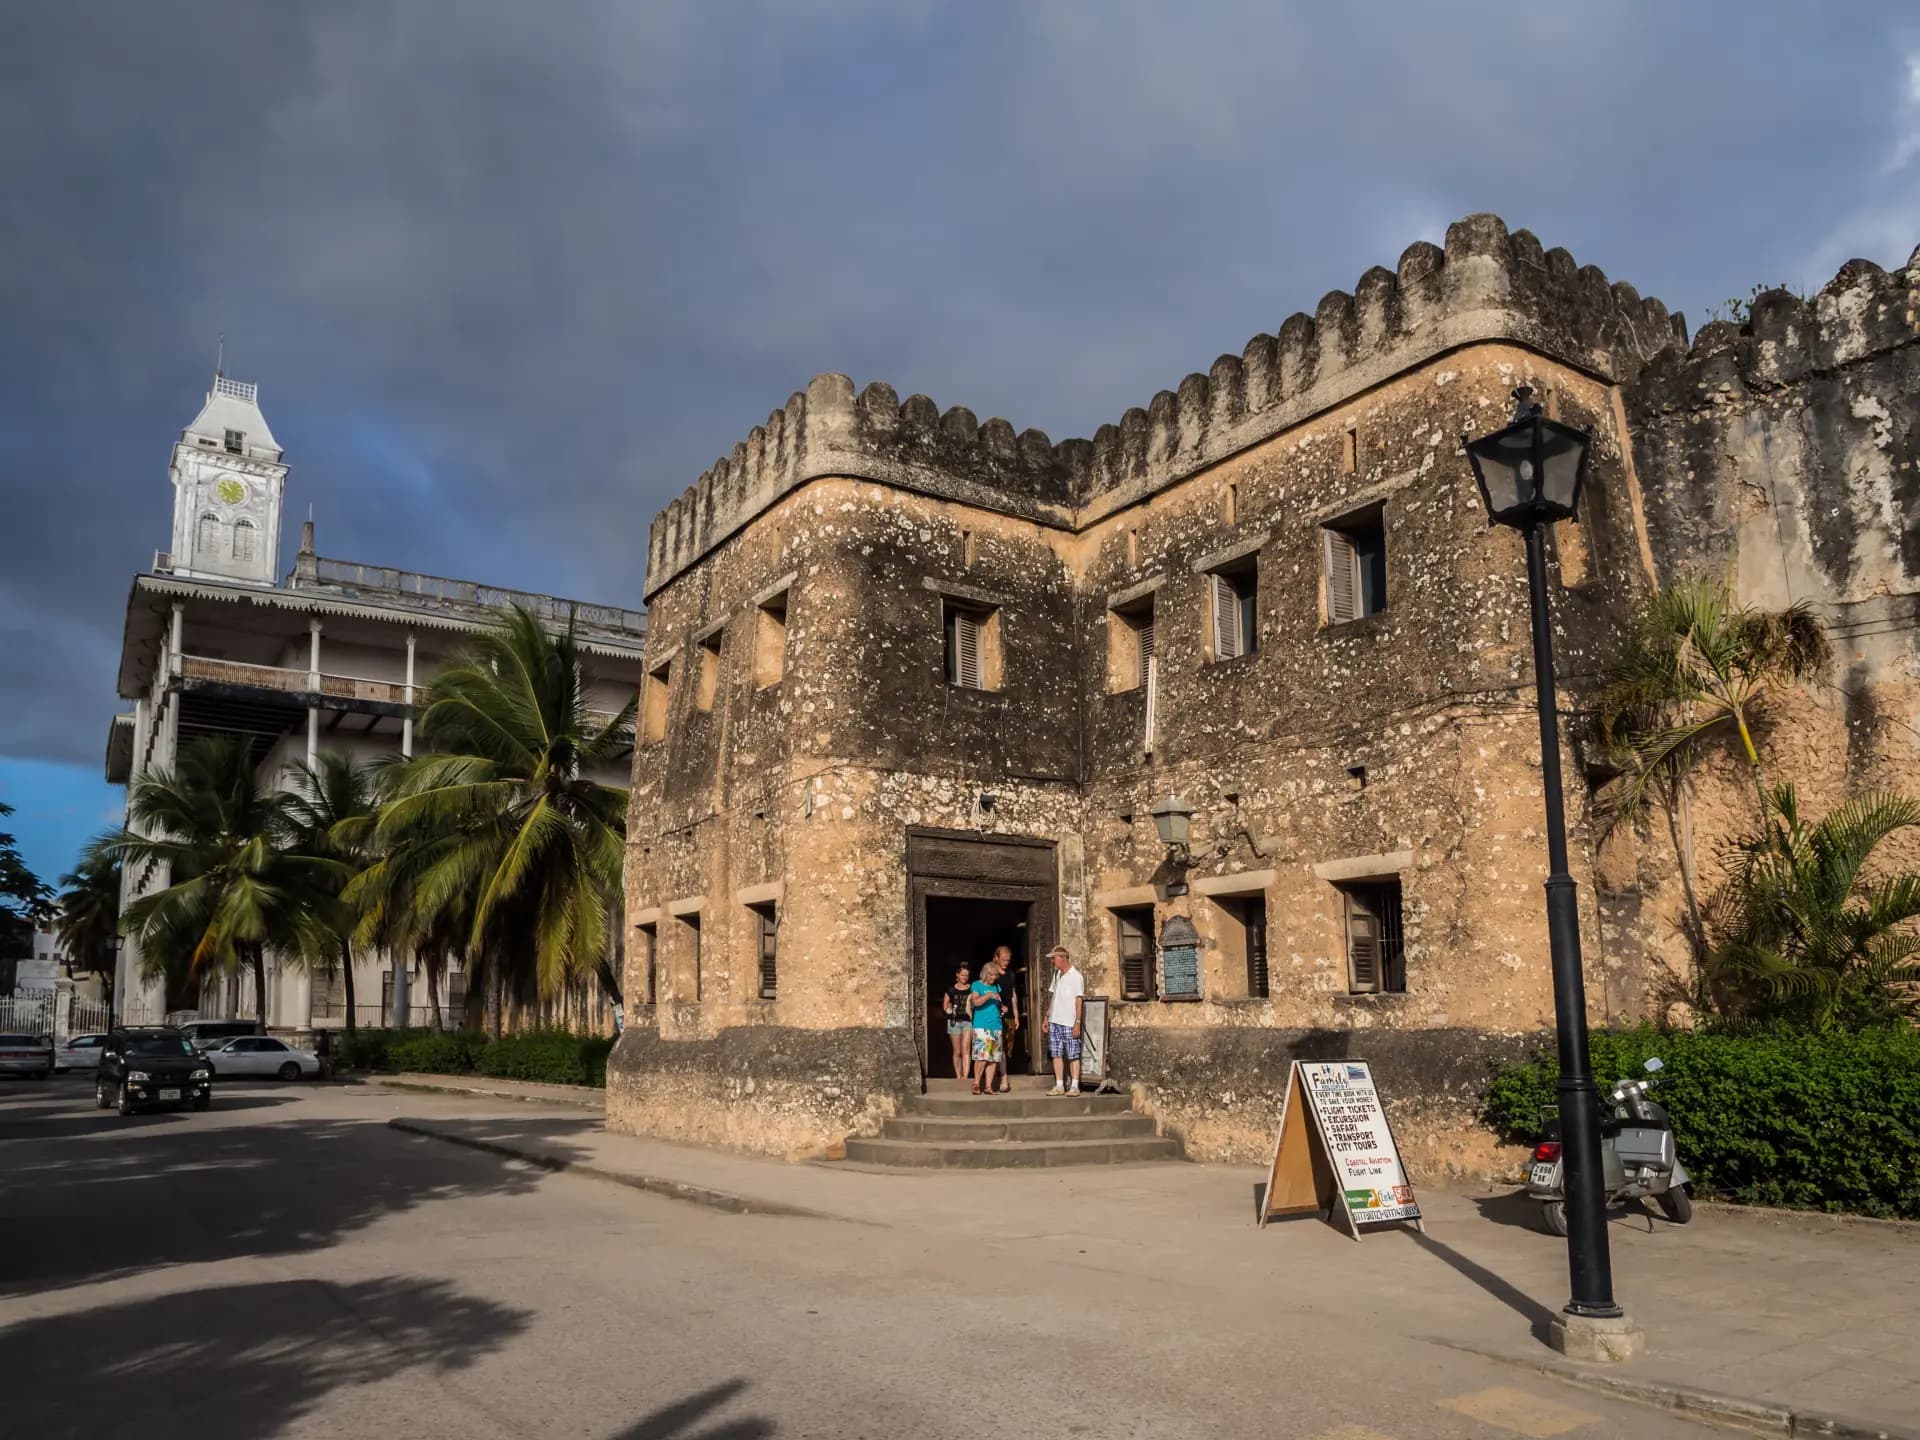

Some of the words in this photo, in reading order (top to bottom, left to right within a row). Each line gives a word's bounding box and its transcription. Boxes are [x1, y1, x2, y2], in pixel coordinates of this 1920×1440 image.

[1312, 1072, 1348, 1088] Family
[1322, 1106, 1345, 1115] FLIGHT
[1347, 1104, 1377, 1114] TICKETS
[1327, 1114, 1370, 1124] EXCURSSION
[1331, 1124, 1358, 1133] SAFARI
[1333, 1131, 1374, 1142] TRANSPORT
[1336, 1142, 1352, 1152] CITY
[1353, 1140, 1378, 1151] TOURS
